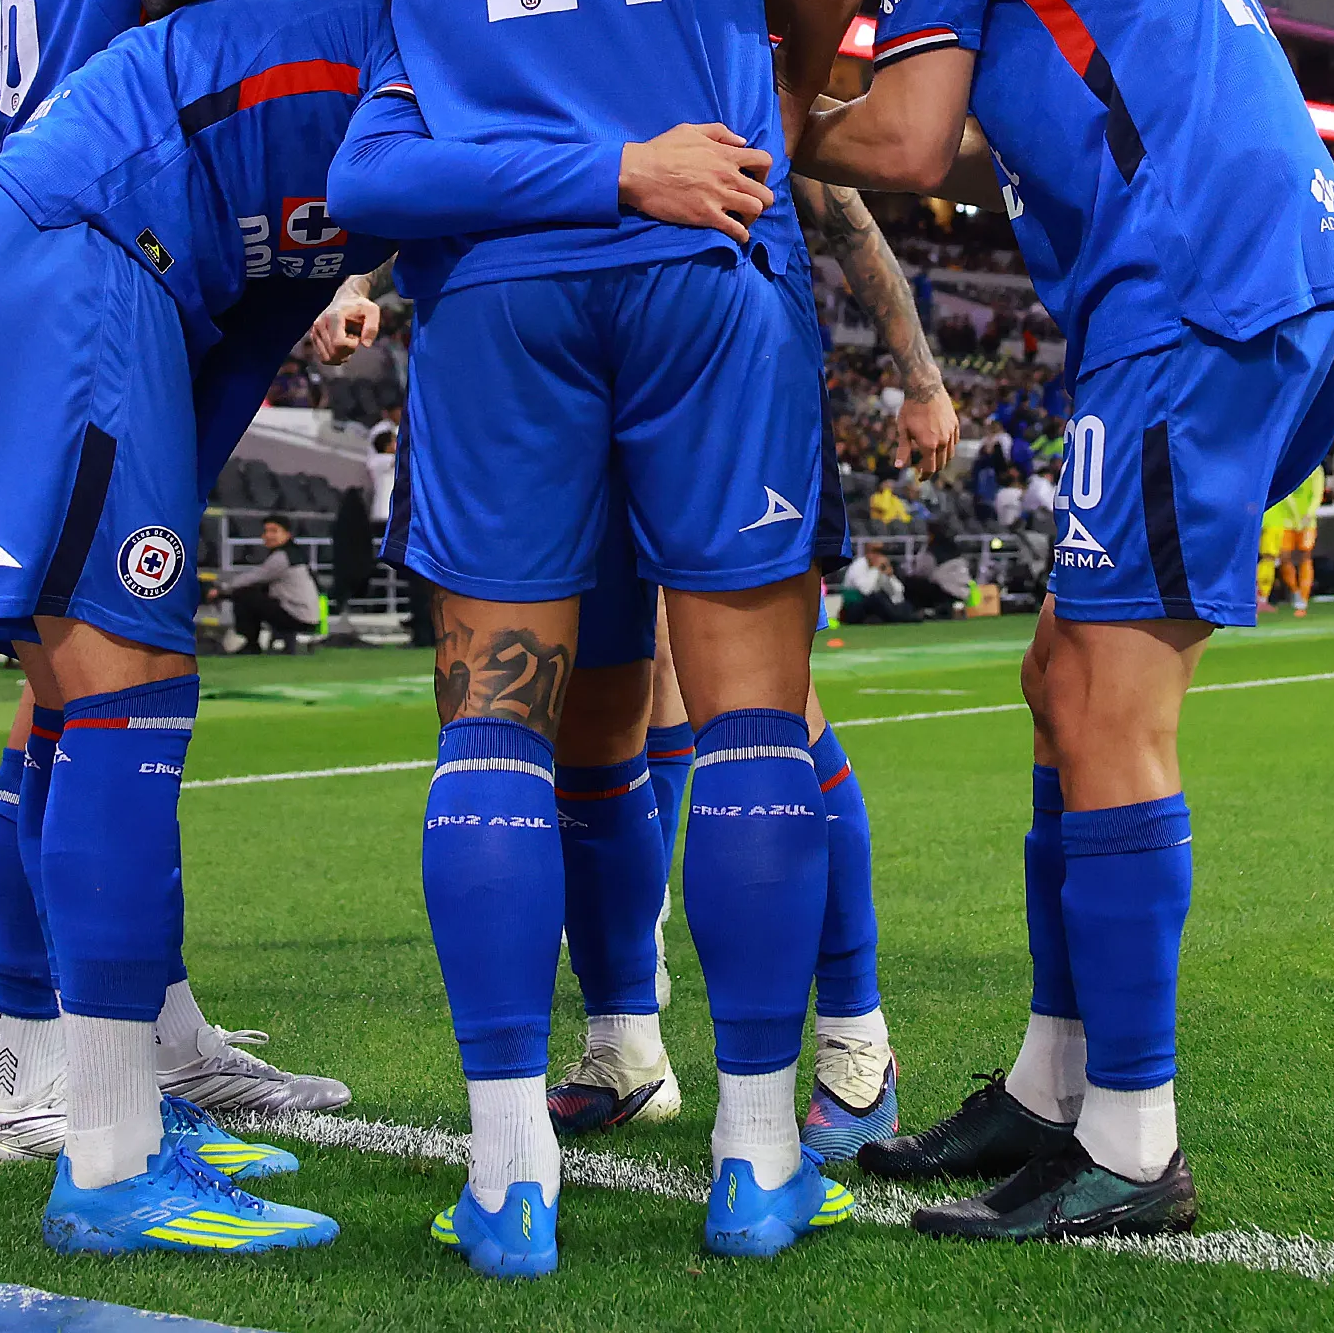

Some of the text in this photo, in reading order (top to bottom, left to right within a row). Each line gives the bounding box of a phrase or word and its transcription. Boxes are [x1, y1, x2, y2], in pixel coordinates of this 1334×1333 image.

[1053, 415, 1106, 510] 20
[132, 531, 150, 544] CLUB
[124, 574, 165, 596] CRUZ AZUL
[693, 804, 814, 817] CRUZ AZUL
[427, 814, 481, 830] CRUZ
[488, 815, 552, 829] AZUL
